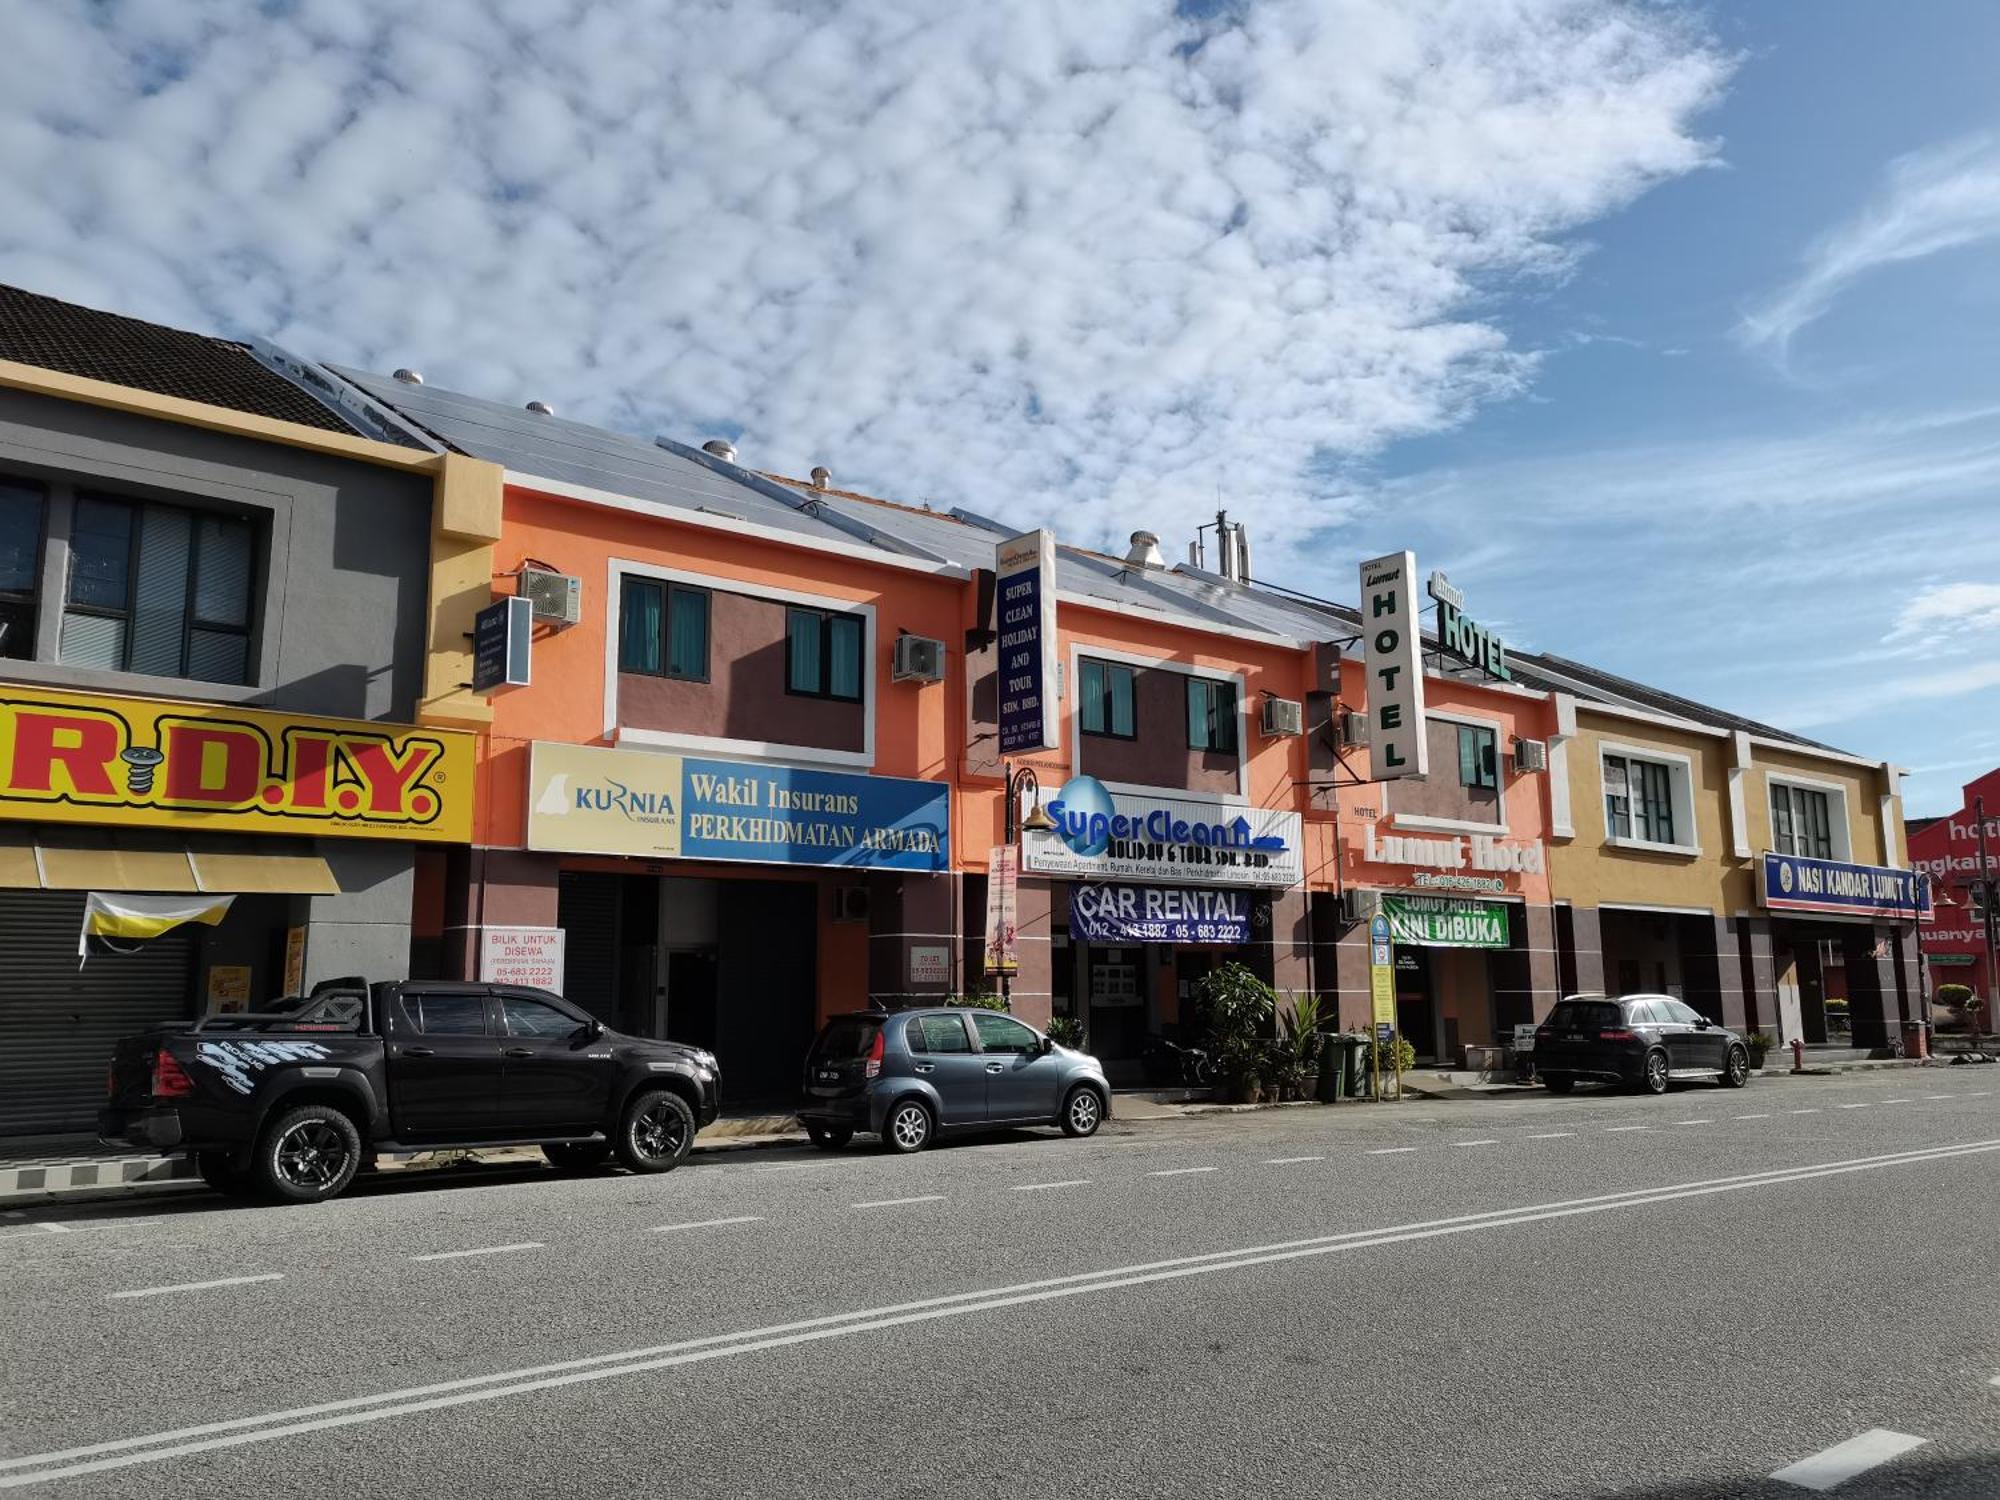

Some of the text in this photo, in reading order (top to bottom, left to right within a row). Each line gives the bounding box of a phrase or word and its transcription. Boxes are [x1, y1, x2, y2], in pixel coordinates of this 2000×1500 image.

[1362, 561, 1381, 573] HOTEL
[1366, 569, 1400, 587] Lumut
[1006, 581, 1032, 601] SUPER
[1006, 604, 1033, 624] CLEAN
[1001, 625, 1038, 649] HOLIDAY
[1440, 601, 1512, 681] HOTEL
[1011, 652, 1030, 669] AND
[1008, 675, 1032, 692] TOUR
[1373, 590, 1406, 768] HOTEL
[576, 776, 675, 822] KURNIA
[690, 774, 858, 815] Wakil Insurans
[1354, 807, 1377, 819] HOTEL
[689, 813, 940, 854] PERKHIDMATAN ARMADA
[1107, 840, 1164, 862] HOLIDAY
[1179, 847, 1212, 865] TOUR
[1364, 823, 1545, 874] Lumut Hotel
[1797, 866, 1904, 901] NASI KANDAR LUMUT
[1078, 886, 1246, 922] CAR RENTAL
[1404, 896, 1487, 915] LUMUT HOTEL
[1175, 924, 1188, 938] 05
[1198, 925, 1215, 938] 683
[1218, 926, 1241, 939] 2222
[1435, 915, 1501, 942] DIBUKA
[491, 935, 557, 945] BILIK UNTUK
[504, 947, 543, 956] DISEWA
[496, 967, 553, 976] 05-683 2222
[220, 1040, 265, 1071] ROGUE
